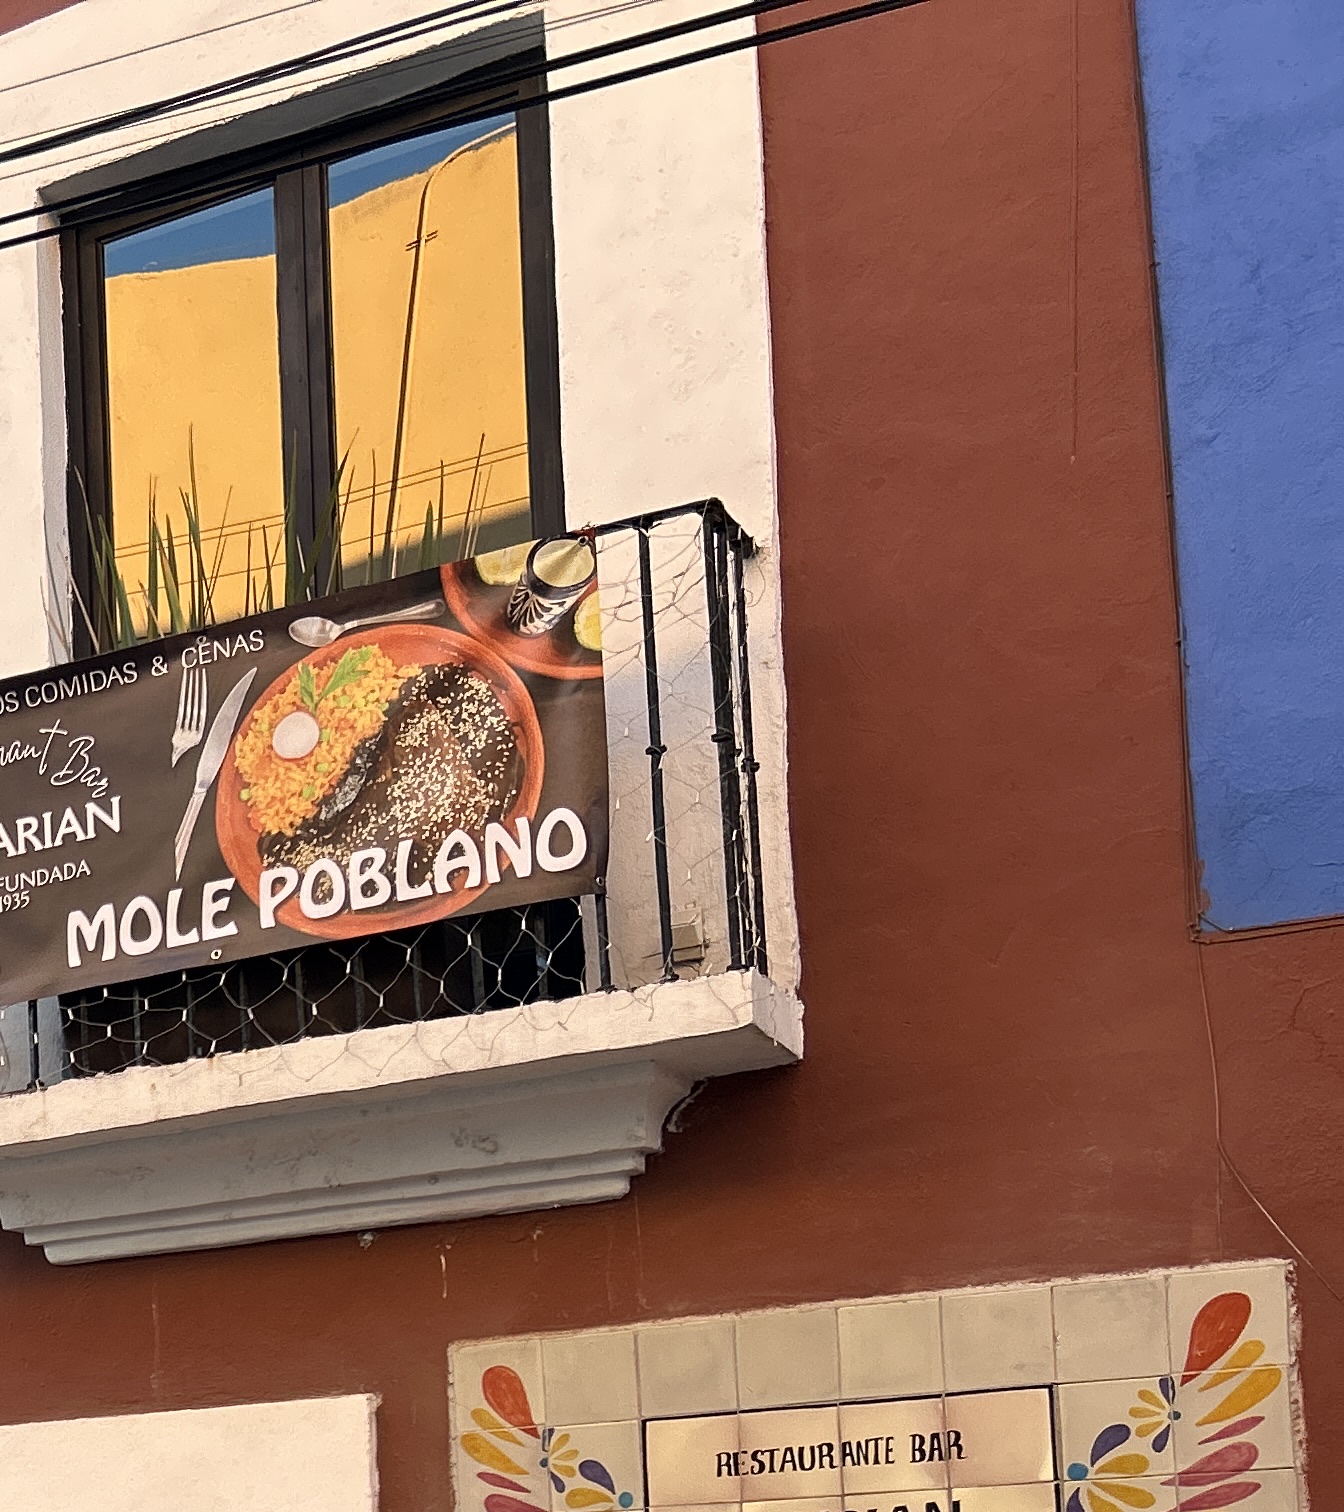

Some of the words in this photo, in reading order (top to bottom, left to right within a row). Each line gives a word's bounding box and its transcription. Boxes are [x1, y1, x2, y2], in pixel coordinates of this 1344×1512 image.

[24, 660, 138, 708] COMIDAS
[150, 655, 169, 677] &
[181, 629, 266, 670] CENAS
[50, 735, 109, 799] Bar
[66, 876, 237, 969] MOLE
[258, 807, 588, 930] POBLANO
[715, 1436, 895, 1478] RESTAURANTE
[909, 1429, 967, 1464] BAR
